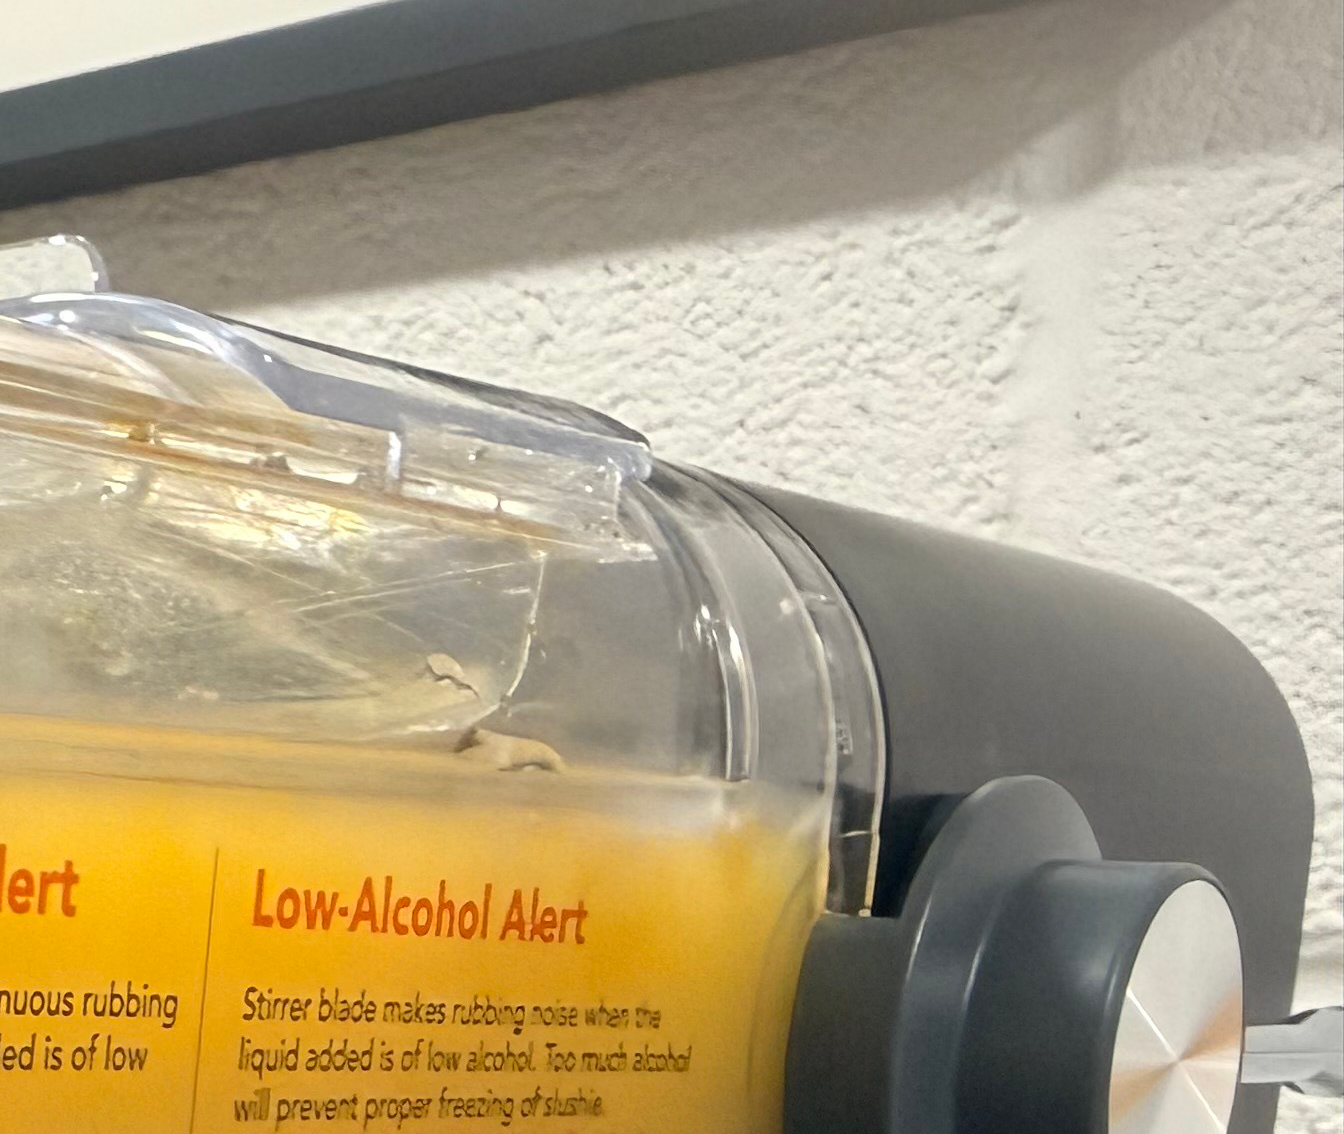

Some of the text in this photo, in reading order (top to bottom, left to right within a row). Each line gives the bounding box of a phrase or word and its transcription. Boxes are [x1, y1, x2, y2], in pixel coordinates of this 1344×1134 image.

[252, 868, 588, 945] Low-Alcohol Alert
[82, 981, 179, 1029] rubbing
[242, 986, 312, 1021] Stirrer
[318, 987, 376, 1022] blade
[383, 990, 446, 1024] makes
[452, 994, 525, 1035] rubbing
[530, 999, 578, 1027] noise
[585, 999, 629, 1028] when
[44, 1036, 63, 1071] is
[72, 1033, 101, 1071] of
[105, 1035, 148, 1071] low
[238, 1037, 692, 1080] liquid added is of low alcohol. Too much alcohol
[233, 1087, 271, 1121] will
[275, 1094, 360, 1132] prevent
[364, 1097, 432, 1130] proper
[438, 1086, 514, 1126] freezing
[521, 1086, 542, 1117] of
